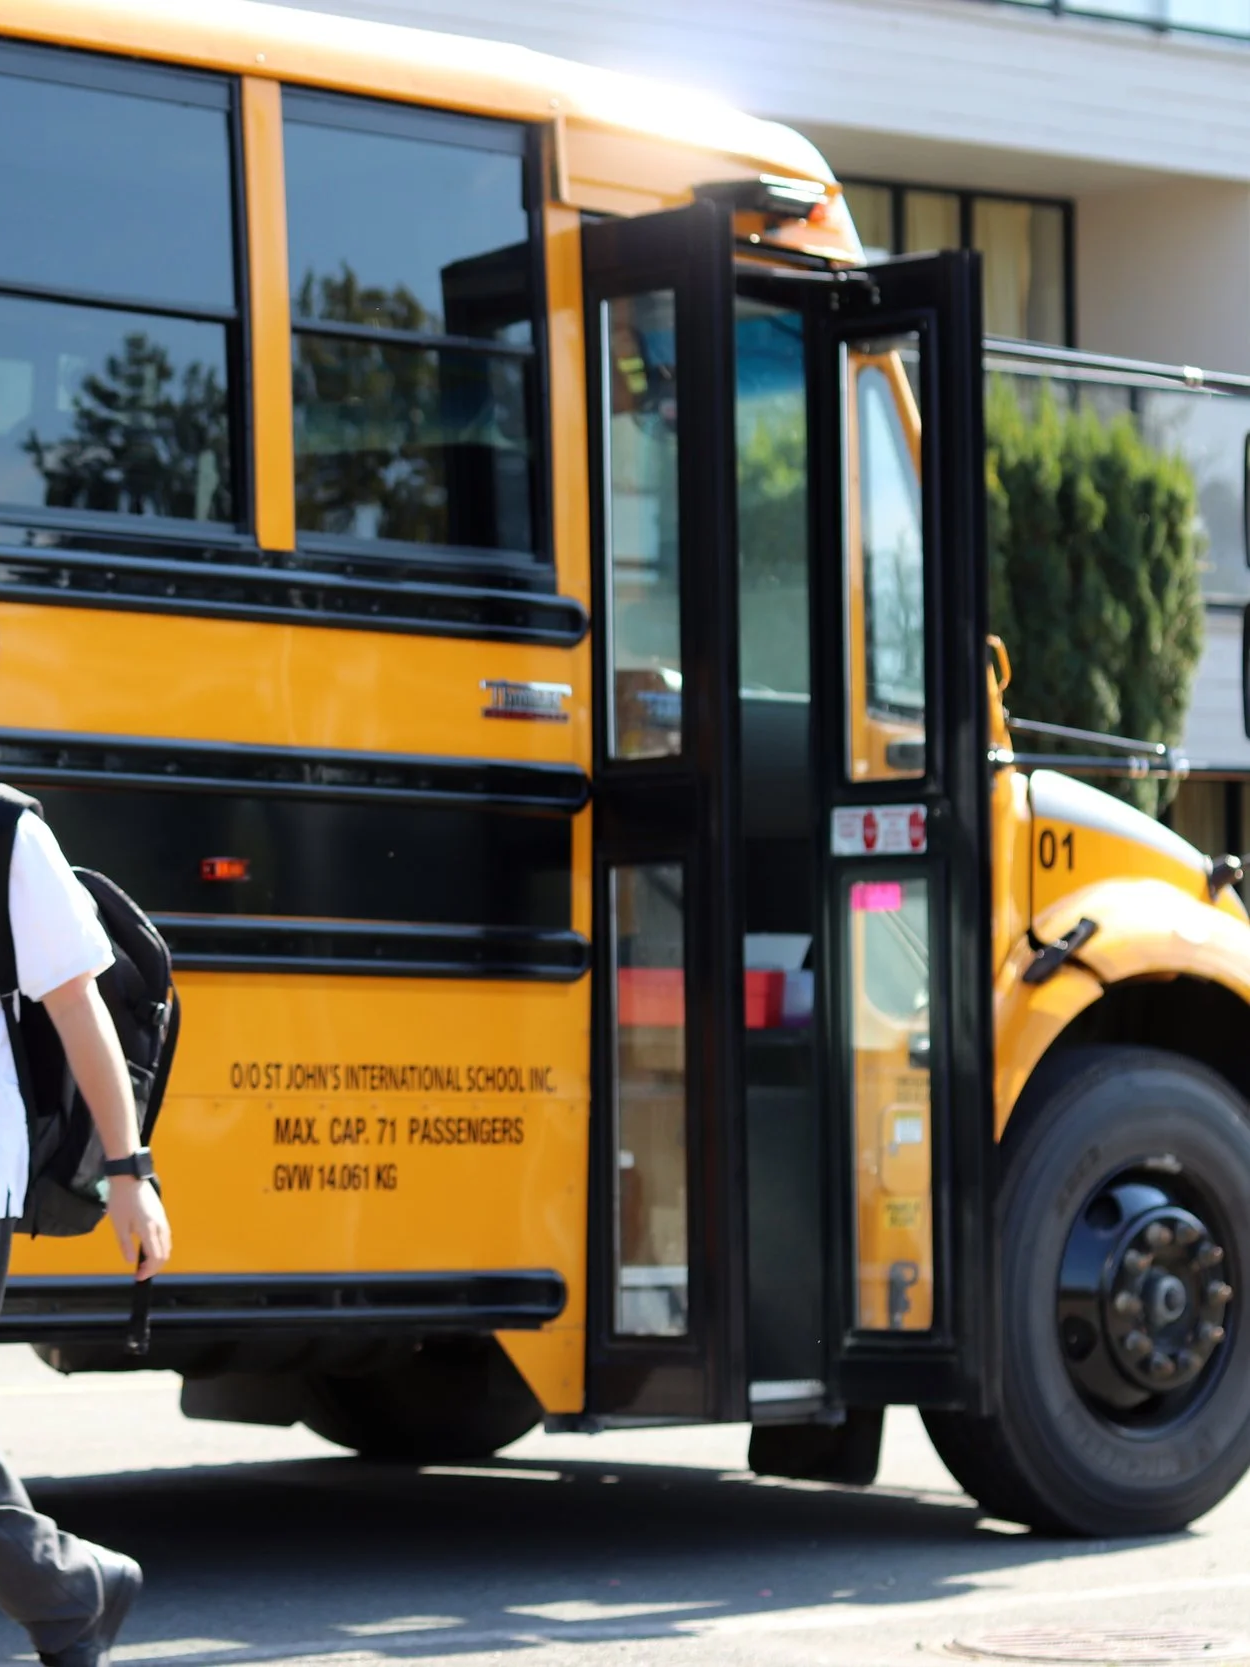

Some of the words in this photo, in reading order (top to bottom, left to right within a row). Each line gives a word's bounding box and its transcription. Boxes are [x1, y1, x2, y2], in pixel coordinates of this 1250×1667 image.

[1039, 829, 1074, 871] 01
[264, 1062, 282, 1090] ST
[286, 1063, 341, 1091] JOHN'S
[345, 1064, 462, 1092] INTERNATIONAL
[467, 1065, 526, 1093] SCHOOL
[530, 1066, 558, 1094] INC.
[274, 1116, 320, 1145] MAX.
[330, 1116, 370, 1145] CAP.
[377, 1117, 397, 1145] 71
[407, 1116, 524, 1145] PASSENGERS
[273, 1163, 313, 1191] GVW
[374, 1163, 398, 1191] KG
